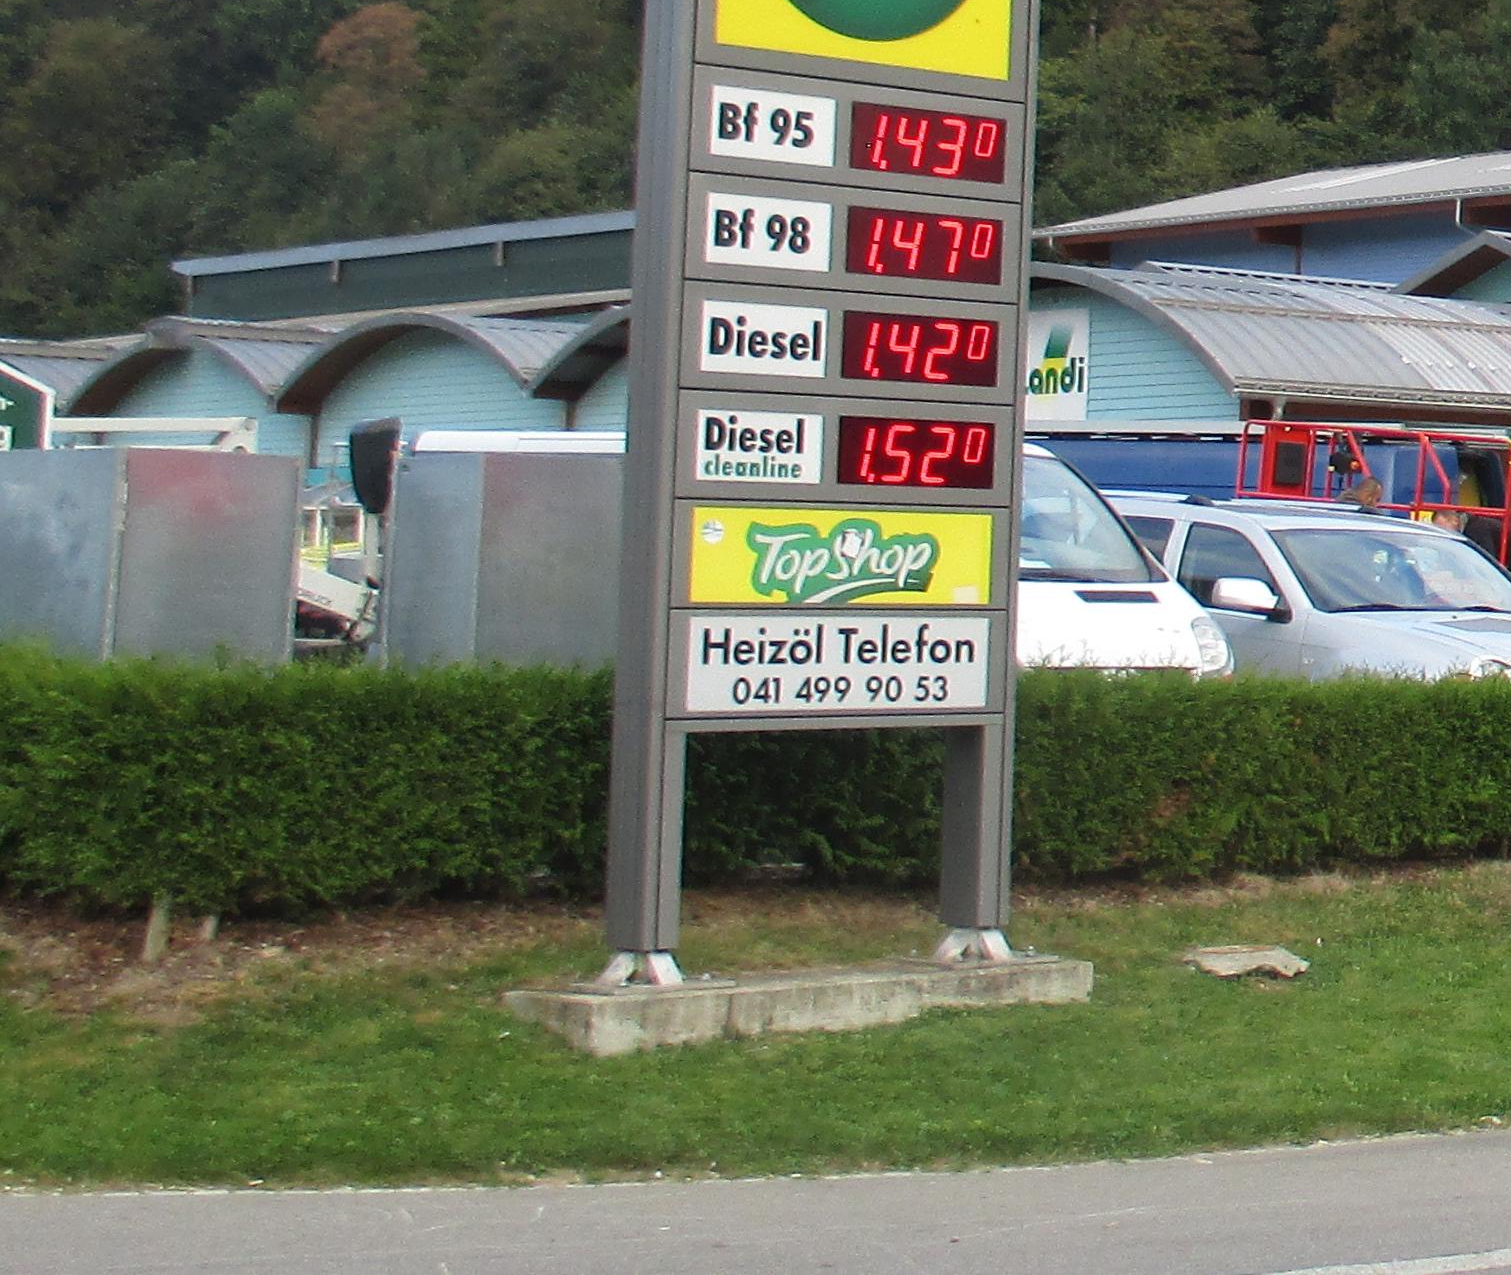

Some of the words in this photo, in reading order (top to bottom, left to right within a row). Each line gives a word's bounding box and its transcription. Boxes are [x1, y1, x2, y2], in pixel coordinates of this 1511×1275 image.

[718, 102, 759, 143] Bf
[769, 107, 815, 149] 95
[714, 208, 755, 250] Bf
[766, 214, 811, 254] 98
[708, 315, 823, 362] Diesel
[1027, 356, 1086, 395] andi
[704, 414, 806, 455] Diesel
[703, 454, 802, 479] cleanline
[702, 624, 825, 664] Heizöl
[837, 623, 976, 664] Telefon
[732, 676, 783, 705] 041
[794, 676, 852, 703] 499
[865, 675, 903, 702] 90
[913, 675, 949, 702] 53
